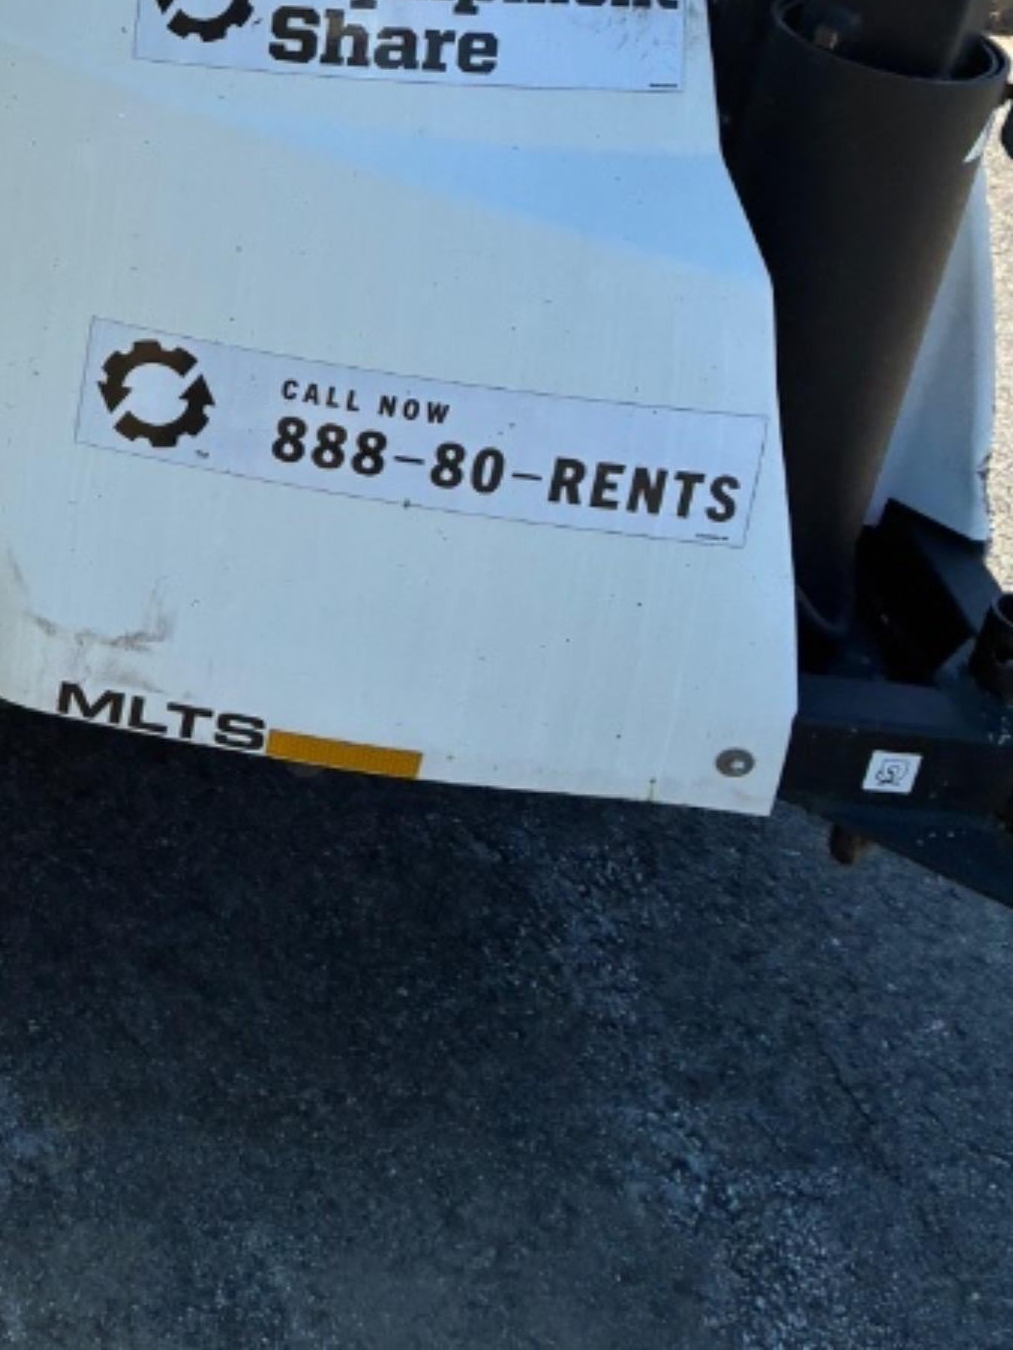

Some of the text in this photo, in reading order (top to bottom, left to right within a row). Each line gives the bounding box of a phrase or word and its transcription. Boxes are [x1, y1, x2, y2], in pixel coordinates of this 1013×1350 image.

[268, 5, 498, 74] Share
[281, 379, 452, 426] CALL NOW
[57, 681, 267, 753] MLTS
